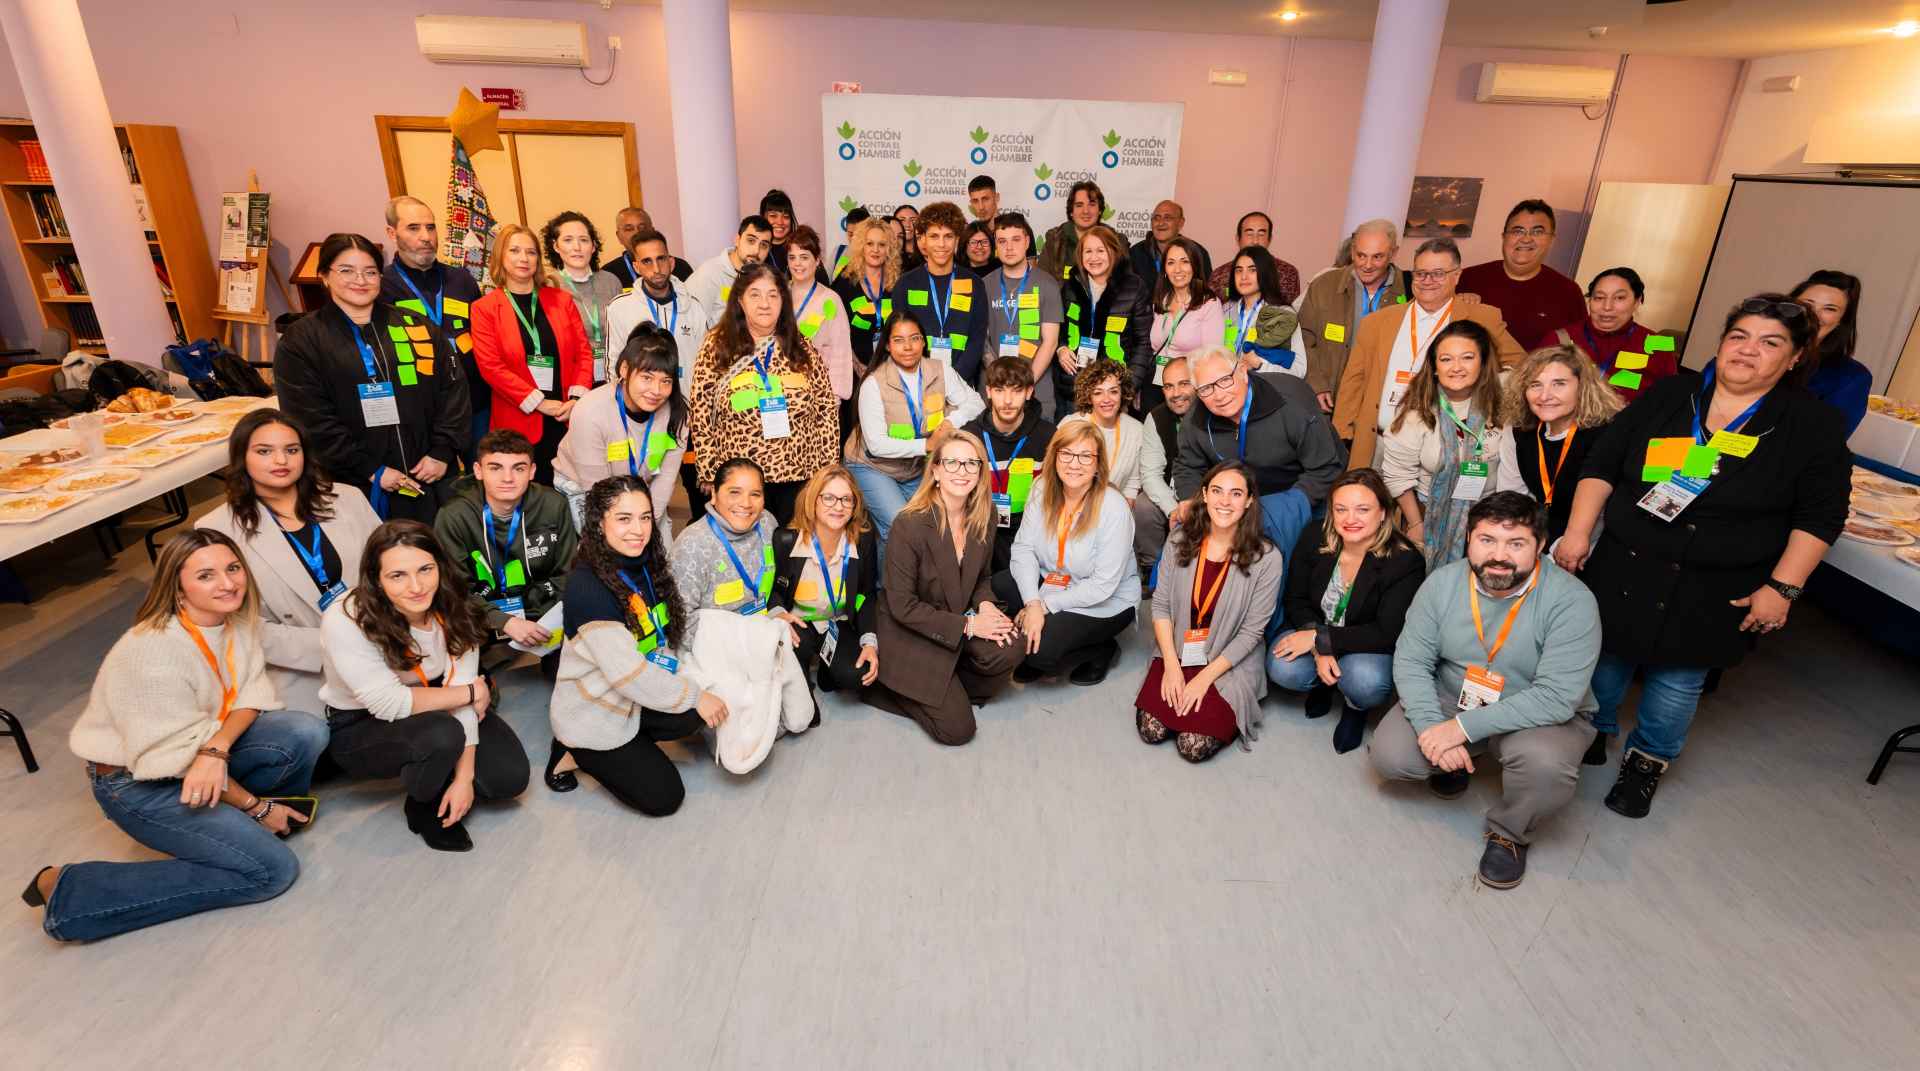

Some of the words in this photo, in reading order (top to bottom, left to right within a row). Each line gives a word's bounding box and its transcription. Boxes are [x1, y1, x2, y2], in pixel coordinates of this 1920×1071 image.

[859, 128, 901, 140] ACCIÓN
[992, 132, 1033, 144] ACCIÓN
[858, 141, 891, 149] CONTRA
[1123, 136, 1166, 148] ACCIÓN
[991, 144, 1024, 153] CONTRA
[1122, 149, 1155, 157] CONTRA
[858, 149, 901, 159] HAMBRE
[991, 152, 1032, 162] HAMBRE
[1121, 157, 1164, 167] HAMBRE
[925, 166, 967, 178] ACCIÓN
[1056, 169, 1097, 181] ACCIÓN
[924, 178, 957, 186] CONTRA
[924, 186, 966, 195] HAMBRE
[1119, 209, 1151, 221] ACCIÓ
